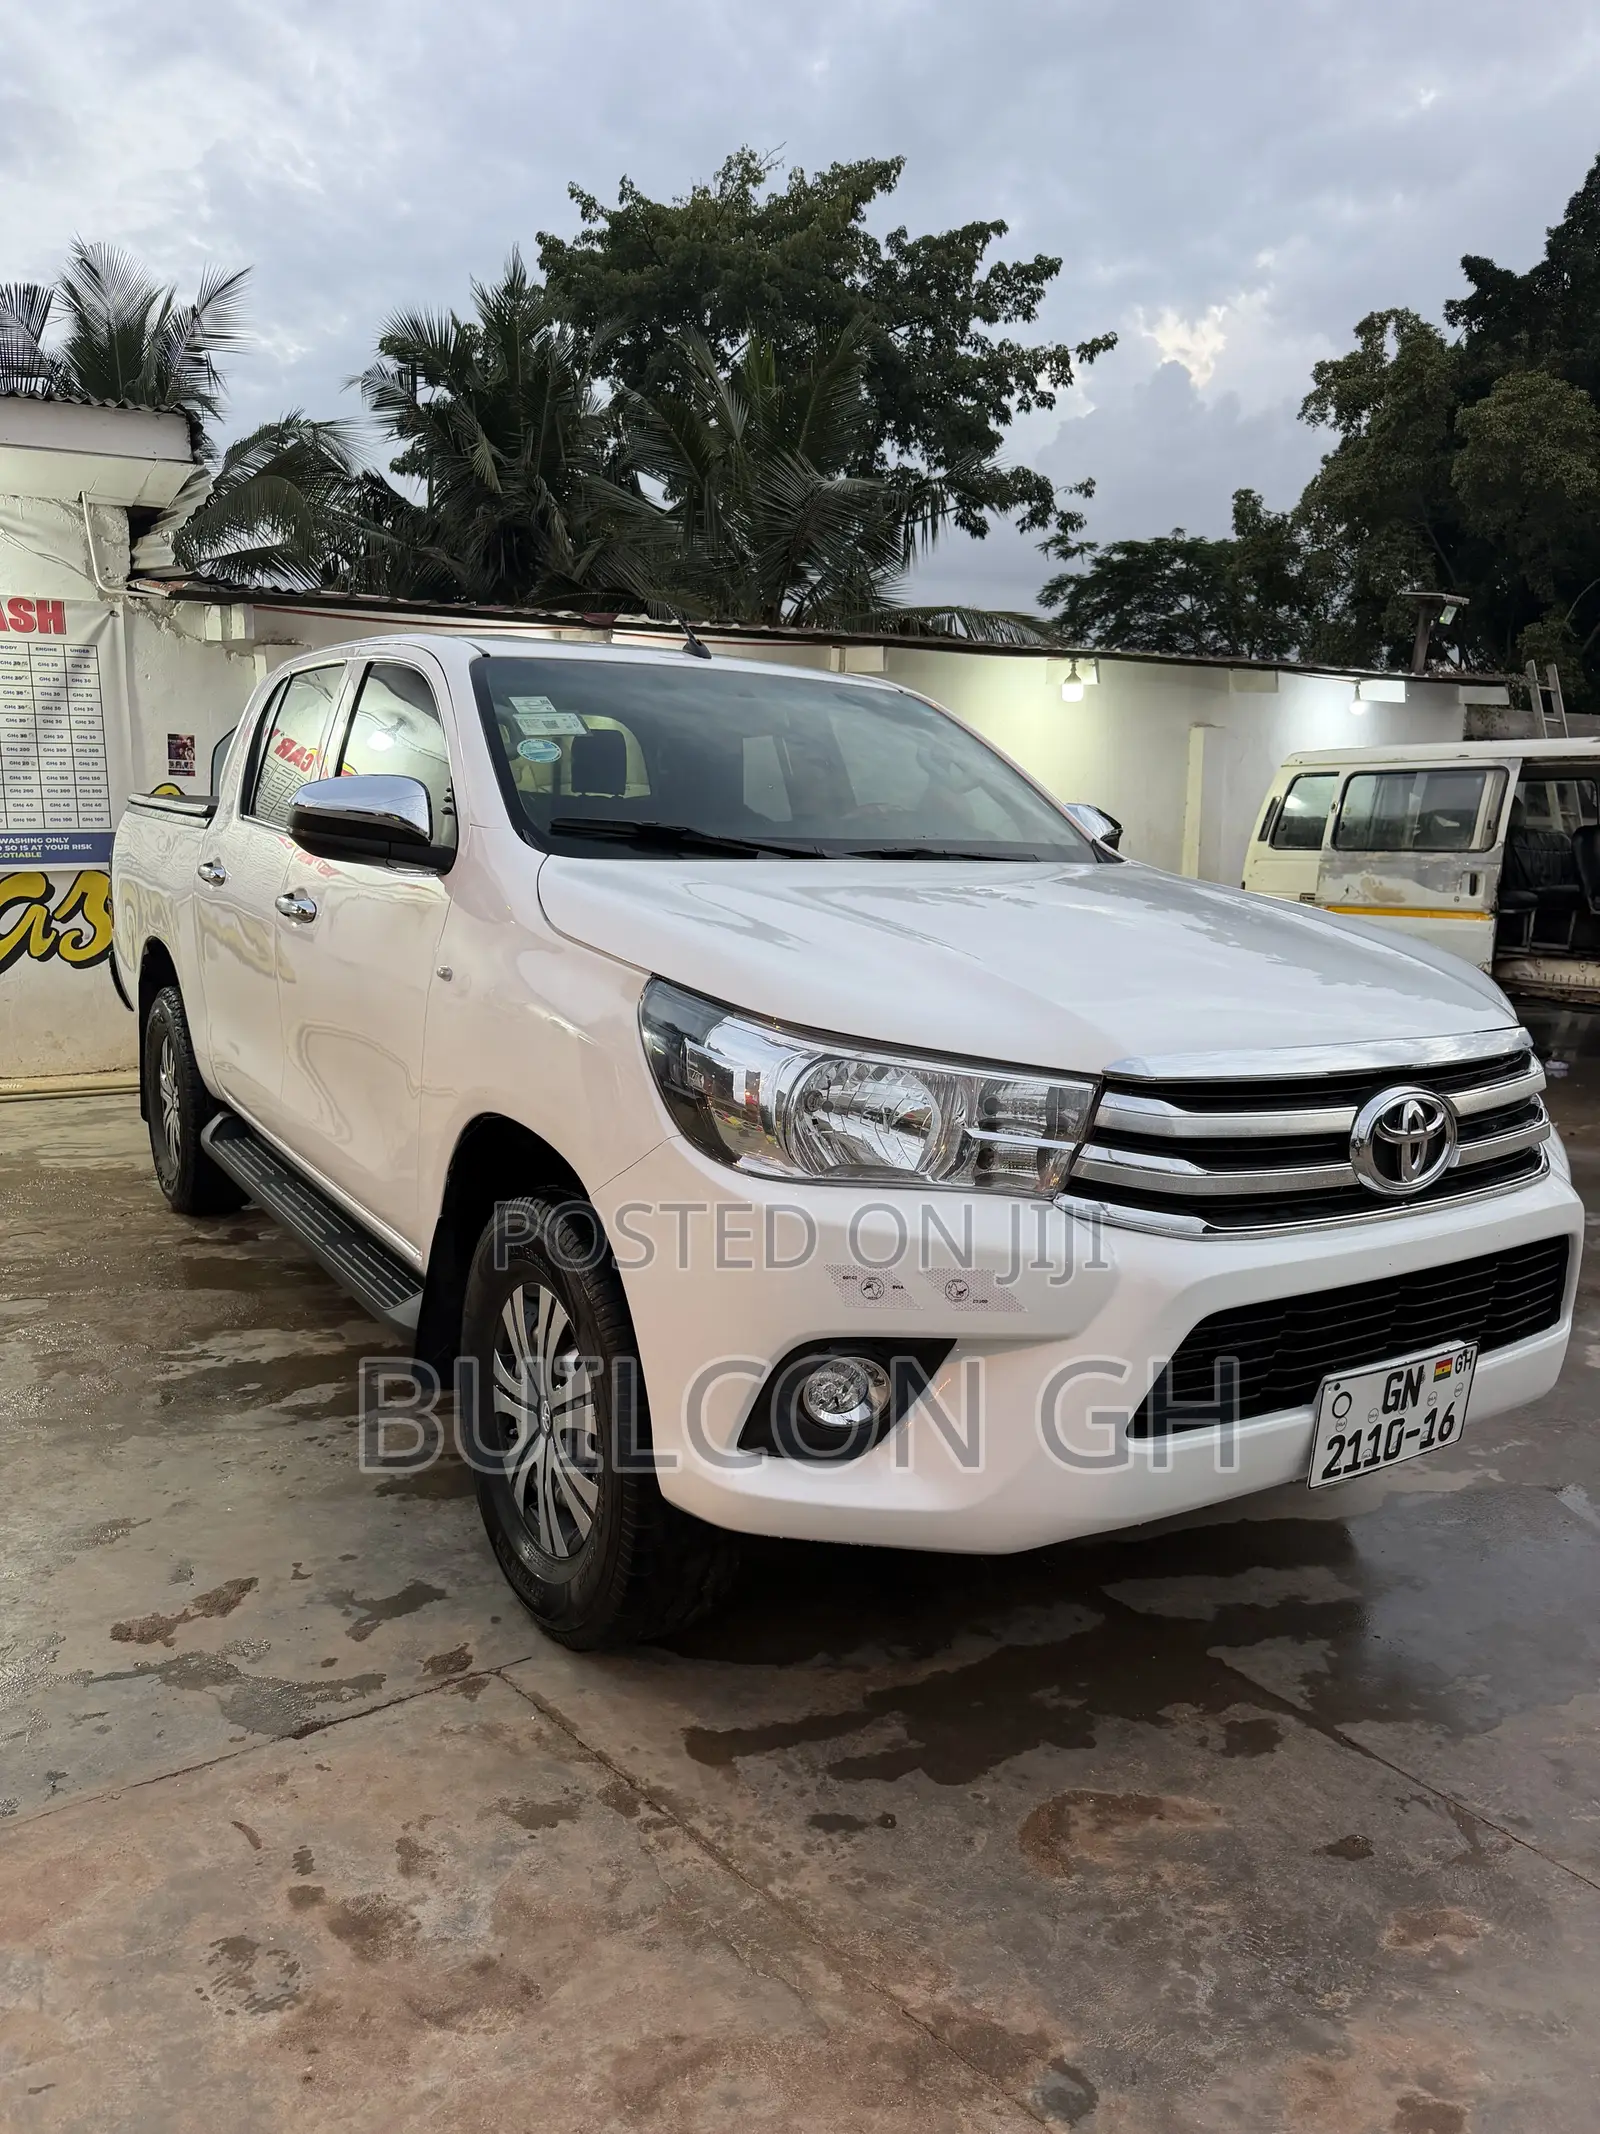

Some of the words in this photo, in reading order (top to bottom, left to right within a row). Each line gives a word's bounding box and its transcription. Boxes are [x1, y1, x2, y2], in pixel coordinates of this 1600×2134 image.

[1382, 1365, 1424, 1414] GN
[1455, 1349, 1474, 1374] GH
[1321, 1401, 1455, 1479] 2110-16
